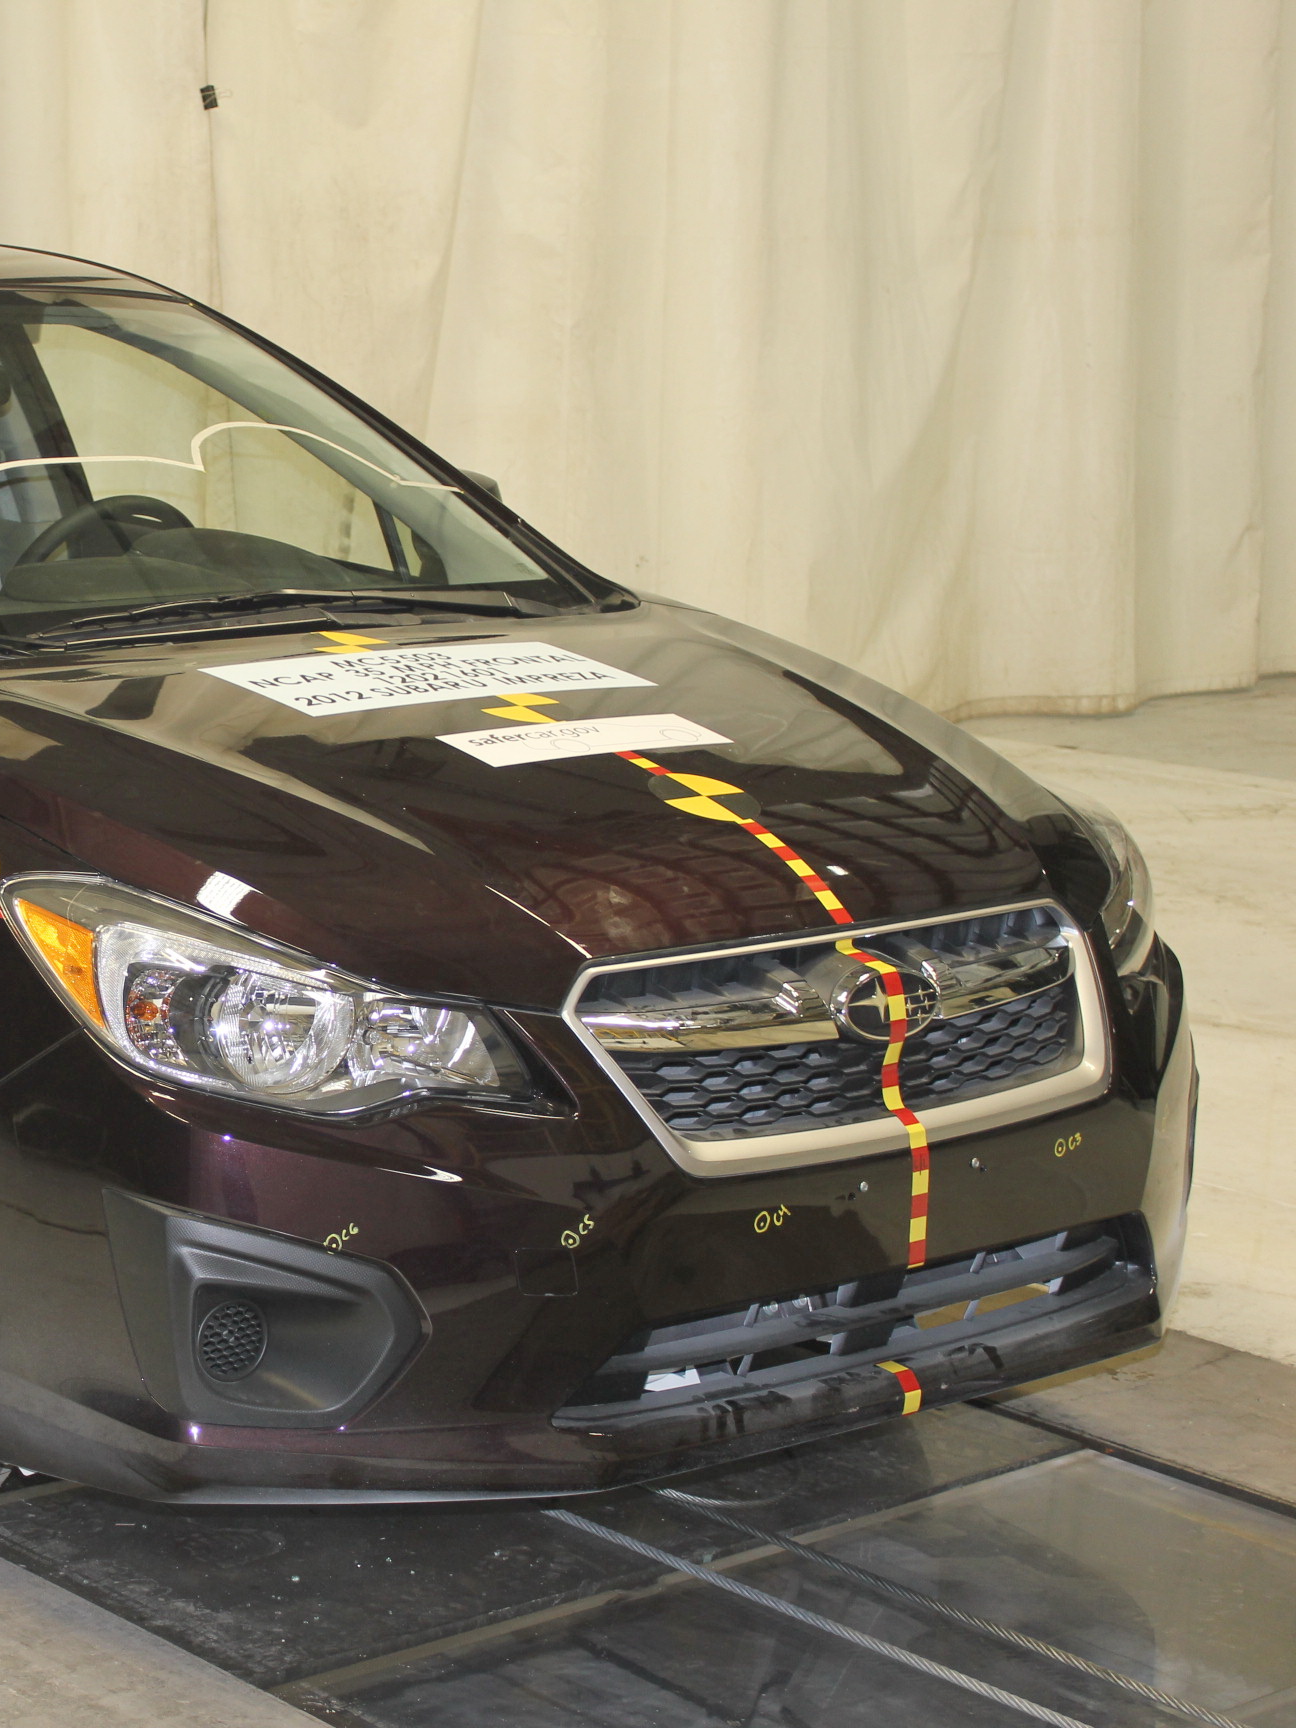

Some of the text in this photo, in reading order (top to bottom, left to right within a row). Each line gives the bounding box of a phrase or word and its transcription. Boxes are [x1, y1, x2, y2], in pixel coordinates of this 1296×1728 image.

[248, 654, 588, 689] NCAP 35 MPH FRONTAL
[330, 652, 452, 670] MC5503
[294, 671, 617, 707] 2012 SUBARU IMPREZA
[373, 667, 508, 687] 12021601
[467, 724, 601, 748] safercar.gov
